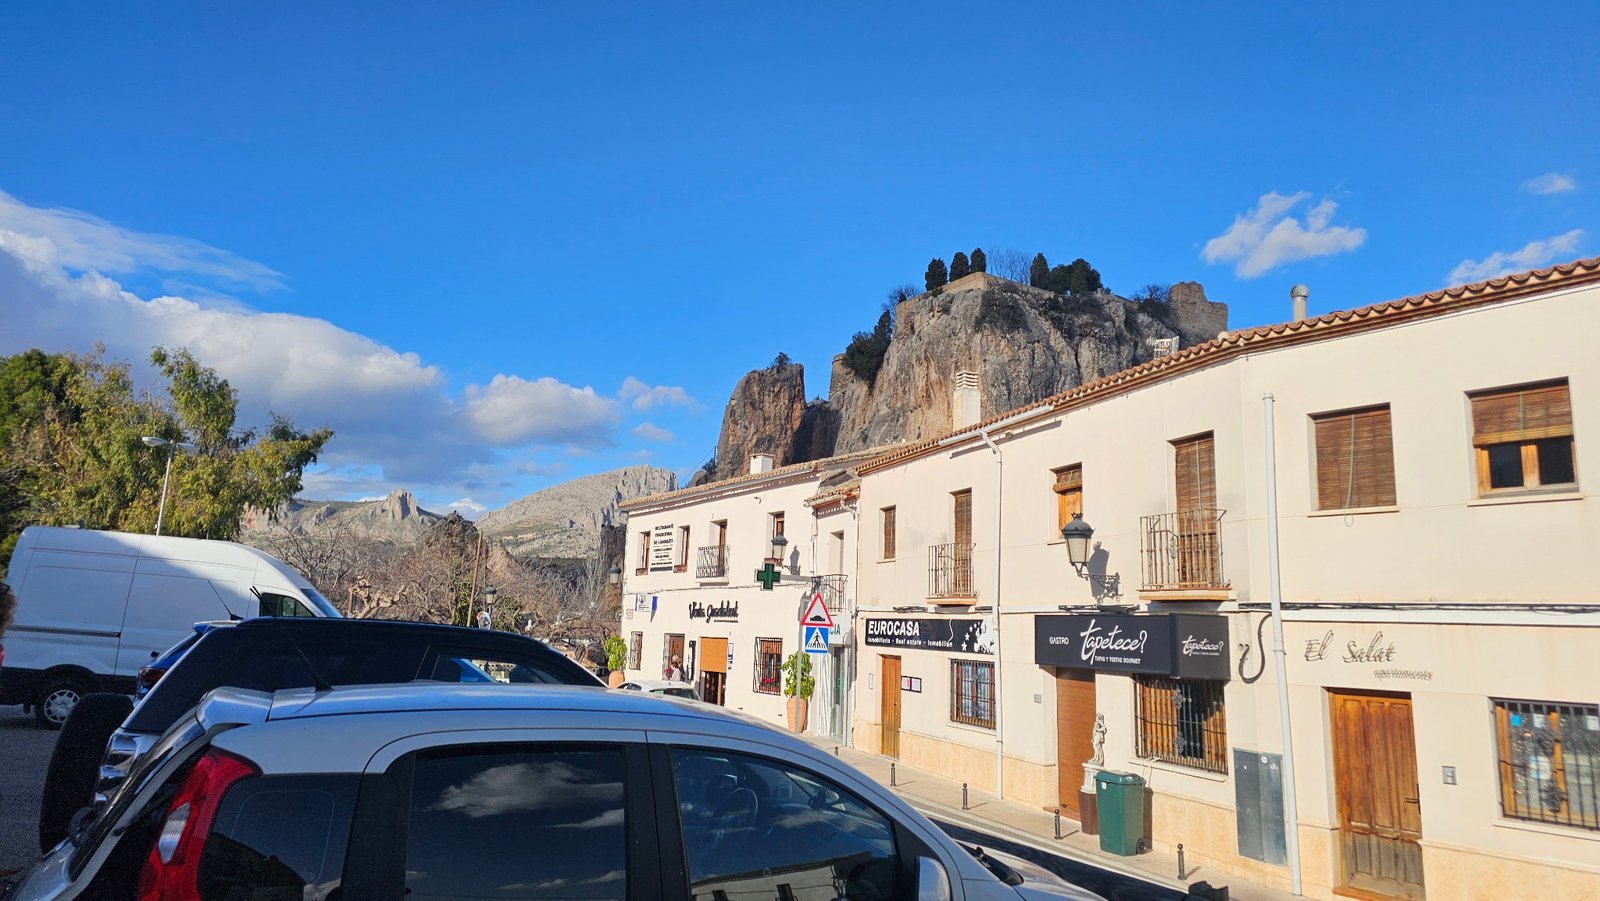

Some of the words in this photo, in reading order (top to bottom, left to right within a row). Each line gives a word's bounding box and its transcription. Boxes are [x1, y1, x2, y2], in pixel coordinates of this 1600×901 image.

[868, 620, 920, 636] EUROCASA
[1049, 636, 1069, 645] GASTRO
[1304, 629, 1334, 662] El
